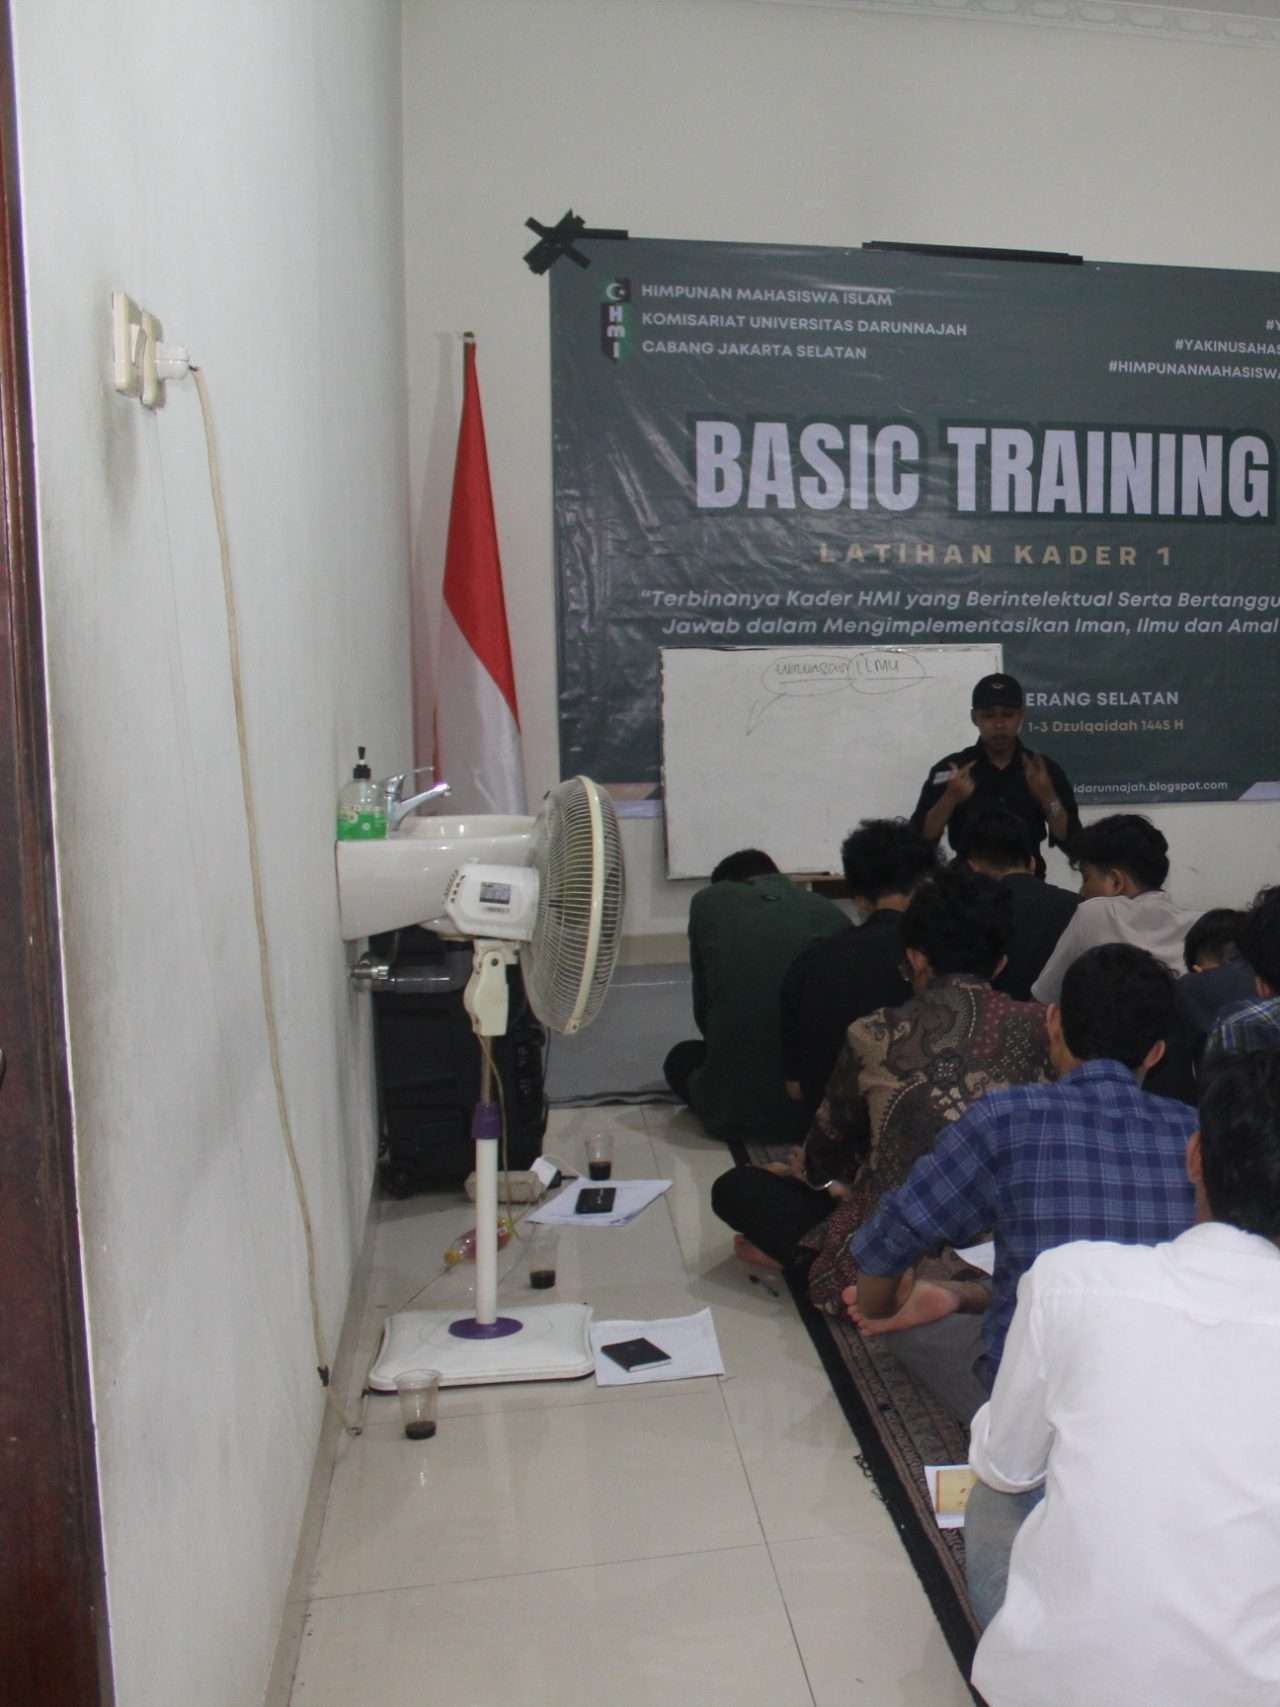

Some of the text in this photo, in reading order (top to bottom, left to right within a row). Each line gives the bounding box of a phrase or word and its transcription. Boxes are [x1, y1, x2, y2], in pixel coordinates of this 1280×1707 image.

[642, 284, 892, 306] HIMPUNAN MAHASISWA ISLAM
[642, 312, 967, 336] KOMISARIAT UNIVERSITAS DARUNNAJAH
[642, 340, 866, 359] CABANG JAKARTA SELATAN
[696, 420, 1269, 518] BASIC TRAINING
[819, 542, 1171, 566] LATIHAN KADER 1
[786, 590, 853, 607] Kader
[858, 591, 900, 606] HMI
[905, 593, 961, 610] yang
[967, 591, 1113, 607] Berintelektual
[1118, 592, 1172, 607] Serta
[662, 617, 740, 634] Jawab
[747, 617, 817, 634] dalam
[823, 617, 1069, 637] Mengimplementasikan
[1075, 617, 1131, 636] Iman,
[1137, 617, 1179, 633] Ilmu
[1184, 617, 1222, 633] dan
[1025, 691, 1179, 706] ERANG SELATAN
[1028, 721, 1048, 732] 1-3
[1052, 719, 1137, 734] Dzulqaidah
[1141, 719, 1170, 730] 1445
[1174, 719, 1184, 730] H
[1073, 780, 1228, 794] idarunnajah.blogspot.com
